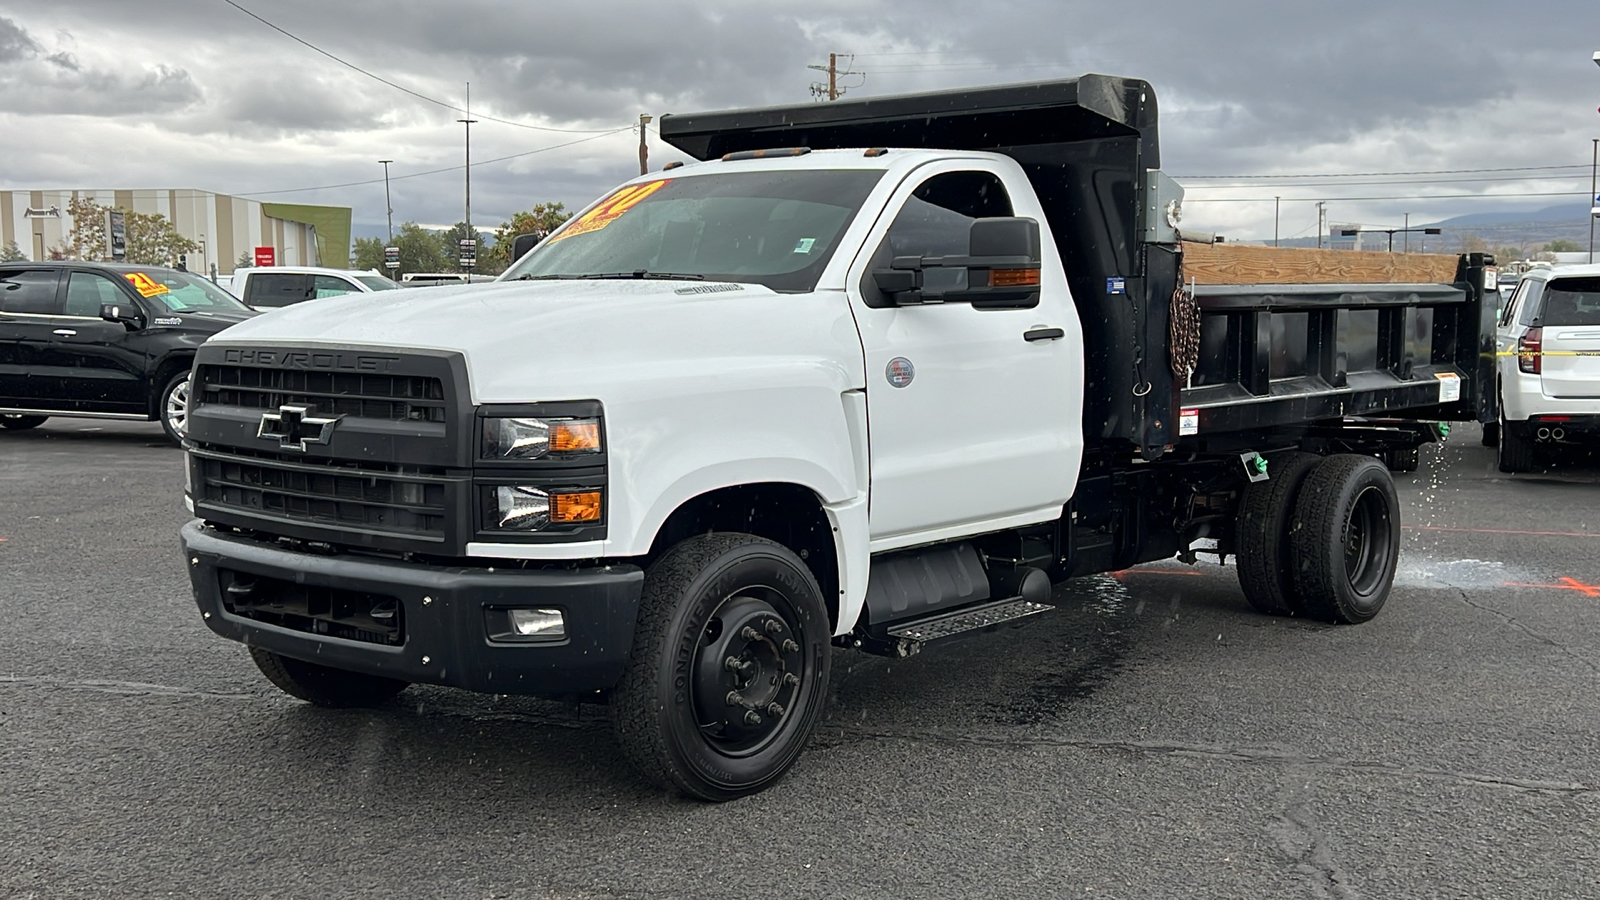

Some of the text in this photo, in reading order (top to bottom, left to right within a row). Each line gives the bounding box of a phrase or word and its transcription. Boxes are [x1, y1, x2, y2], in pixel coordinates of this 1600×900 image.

[579, 180, 665, 225] 20
[125, 272, 159, 290] 21
[225, 350, 400, 372] CHEVROLET
